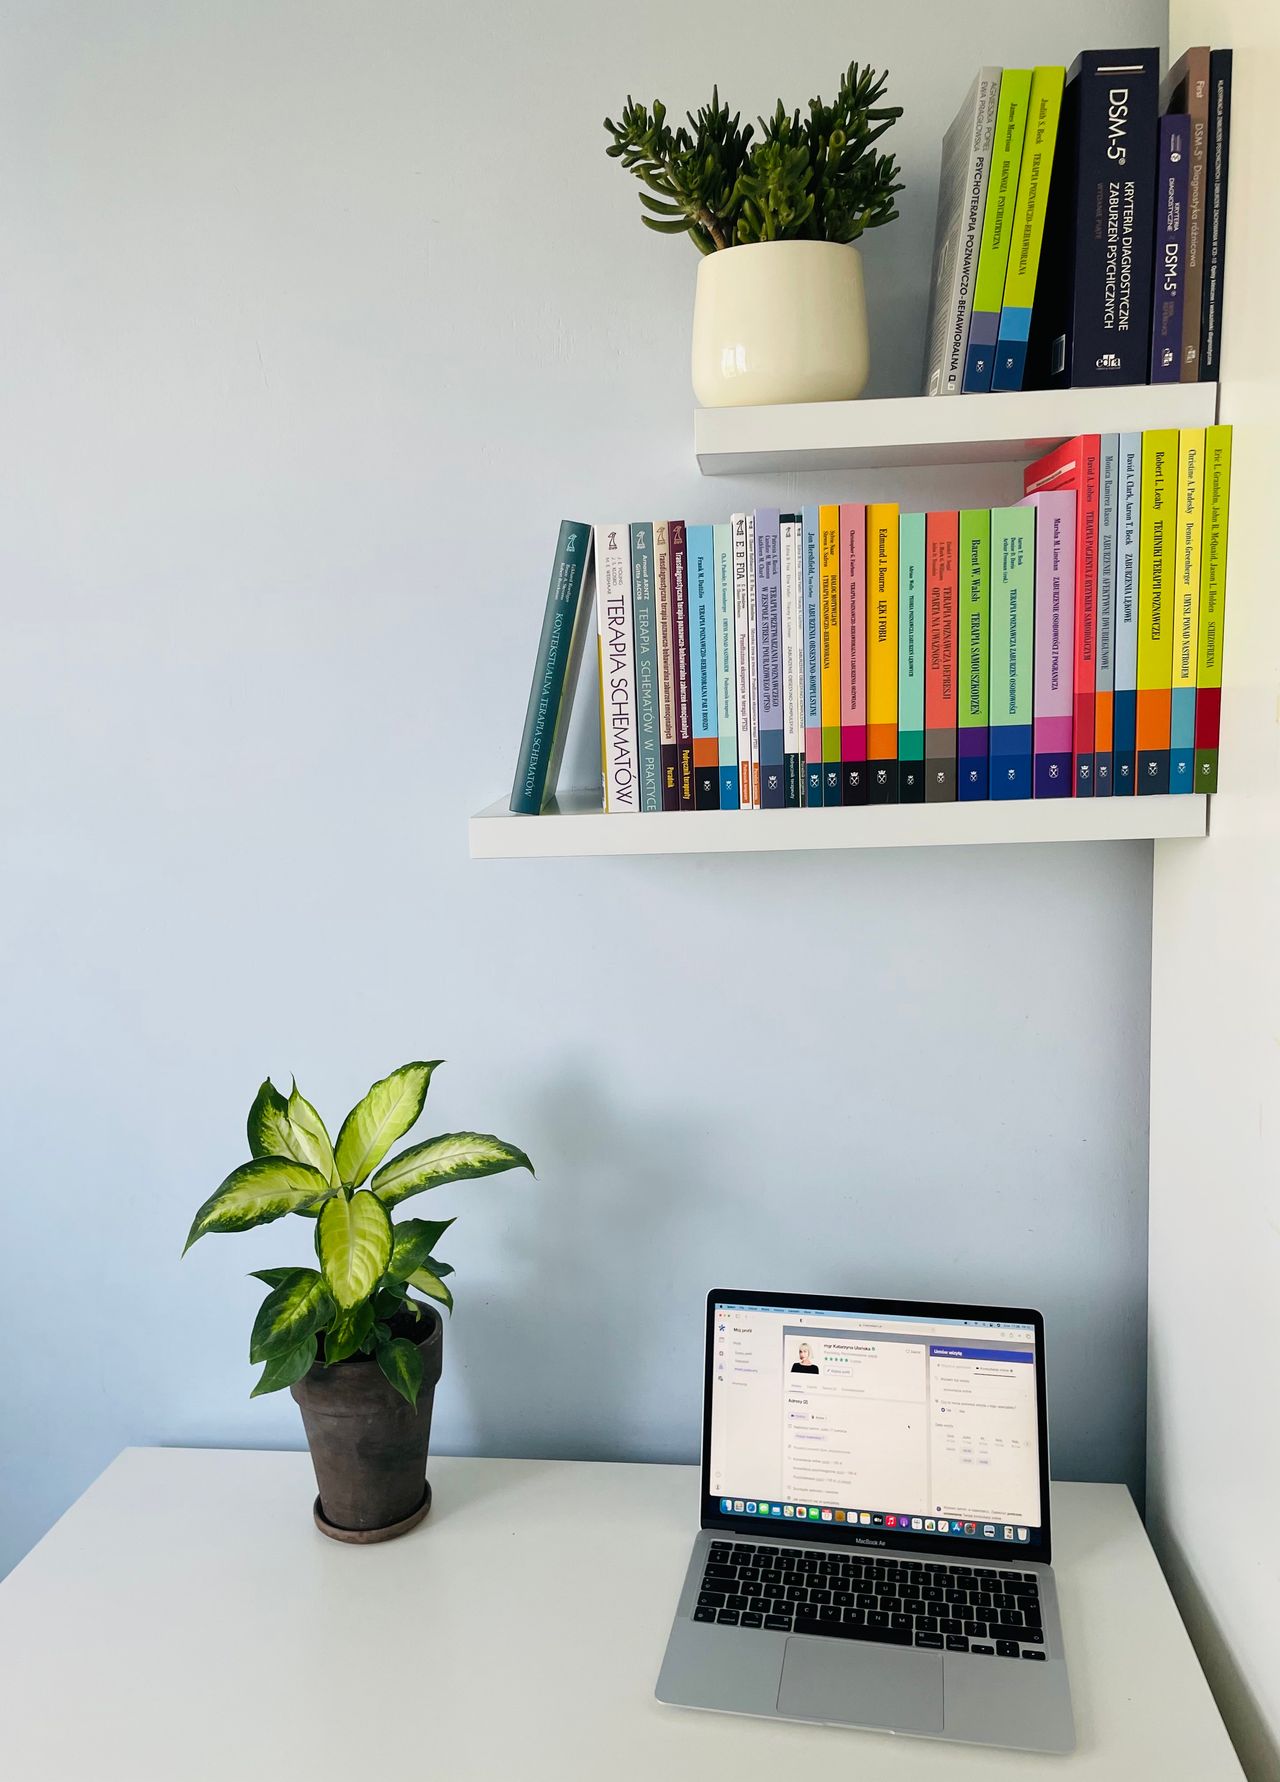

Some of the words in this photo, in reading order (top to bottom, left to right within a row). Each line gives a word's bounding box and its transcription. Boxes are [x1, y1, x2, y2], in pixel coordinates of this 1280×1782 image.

[1196, 81, 1205, 98] First
[1009, 102, 1017, 122] James
[1040, 99, 1048, 119] Judith
[1005, 124, 1015, 152] Morrison
[1036, 129, 1044, 144] Beck
[1107, 89, 1128, 165] DSM-5®
[1000, 161, 1010, 193] DIAGNOZA
[1031, 154, 1041, 181] TERAPIA
[967, 157, 984, 231] PSYCHOTERAPIA
[1122, 182, 1135, 234] KRYTERIA
[1190, 165, 1202, 219] Diagnostyka
[992, 196, 1005, 250] PSYCHIATRYCZNA
[1108, 182, 1120, 242] ZABURZEŃ
[1018, 182, 1037, 275] POZNAWCZO-BEHAWIORALNA
[1190, 222, 1200, 267] różnicowa
[1119, 237, 1132, 331] DIAGNOSTYCZNE
[1164, 243, 1178, 296] DSM-5®
[1104, 245, 1117, 328] PSYCHICZNYCH
[950, 235, 974, 371] POZNAWCZO-BEHAWIORALNA
[1087, 457, 1095, 475] David
[1105, 456, 1113, 479] Monica
[1126, 454, 1135, 472] David
[1155, 452, 1164, 477] Robert
[1187, 449, 1196, 479] Christine
[1214, 449, 1222, 462] Eric
[1086, 484, 1094, 502] Jobes
[1104, 480, 1112, 506] Ramirez
[1125, 481, 1134, 500] Clark,
[1153, 488, 1163, 510] Leahy
[1185, 488, 1194, 514] Padesky
[1211, 472, 1220, 505] Granholm,
[1086, 511, 1094, 540] TERAPIA
[1104, 508, 1112, 526] Basco
[1125, 502, 1133, 520] Aaron
[1211, 506, 1219, 522] John
[736, 541, 744, 549] E.
[879, 529, 887, 557] Edmund
[1125, 529, 1133, 545] Beck
[1153, 520, 1163, 557] TECHNIKI
[1185, 523, 1193, 545] Dennis
[1209, 532, 1218, 562] McQuaid,
[736, 552, 744, 560] B.
[972, 540, 980, 565] Barent
[1085, 541, 1093, 573] PACJENTA
[1103, 535, 1111, 576] ZABURZENIE
[1184, 547, 1193, 585] Greenberger
[659, 553, 668, 601] Transdiagnostyczna
[675, 552, 683, 600] Transdiagnostyczna
[737, 563, 745, 579] FOA
[879, 568, 887, 592] Bourne
[971, 568, 980, 578] W.
[1124, 554, 1133, 594] ZABURZENIA
[1152, 559, 1162, 589] TERAPII
[932, 588, 940, 615] OPARTA
[943, 587, 951, 618] TERAPIA
[971, 580, 980, 602] Walsh
[1102, 578, 1111, 617] AFEKTYWNE
[660, 603, 668, 620] terapia
[676, 602, 685, 619] terapia
[808, 604, 816, 640] ZABURZENIA
[877, 600, 886, 615] LĘK
[932, 617, 940, 627] NA
[1123, 596, 1132, 623] LĘKOWE
[1151, 592, 1161, 640] POZNAWCZEJ
[607, 595, 626, 673] TERAPIA
[639, 608, 650, 654] TERAPIA
[770, 614, 778, 662] PRZETWARZANIA
[943, 620, 951, 663] POZNAWCZA
[971, 613, 980, 646] TERAPIA
[1052, 614, 1060, 650] OSOBOWOŚCI
[1101, 618, 1110, 670] DWUBIEGUNOWE
[1182, 617, 1190, 639] PONAD
[542, 613, 563, 695] KONTEKSTUALNA
[661, 622, 670, 680] poznawczo-behawioralna
[677, 621, 686, 680] poznawczo-behawioralna
[1181, 641, 1189, 678] NASTROJEM
[1206, 622, 1215, 668] SCHIZOFRENIA
[762, 646, 770, 691] POURAZOWEGO
[809, 641, 817, 716] OBSESYJNO-KOMPULSYJNE
[1009, 649, 1018, 677] ZABURZEŃ
[640, 660, 655, 733] SCHEMATÓW
[943, 665, 951, 699] DEPRESJI
[971, 648, 982, 715] SAMOUSZKODZEŃ
[1009, 679, 1017, 715] OSOBOWOŚCI
[535, 698, 548, 735] TERAPIA
[664, 704, 673, 739] emocjonalnych
[680, 704, 689, 738] emocjonalnych
[610, 679, 636, 804] SCHEMATÓW
[644, 740, 653, 750] W
[525, 738, 541, 797] SCHEMATÓW
[681, 750, 690, 775] Podręcznik
[645, 758, 656, 810] PRAKTYCE
[682, 777, 691, 799] terapeuty
